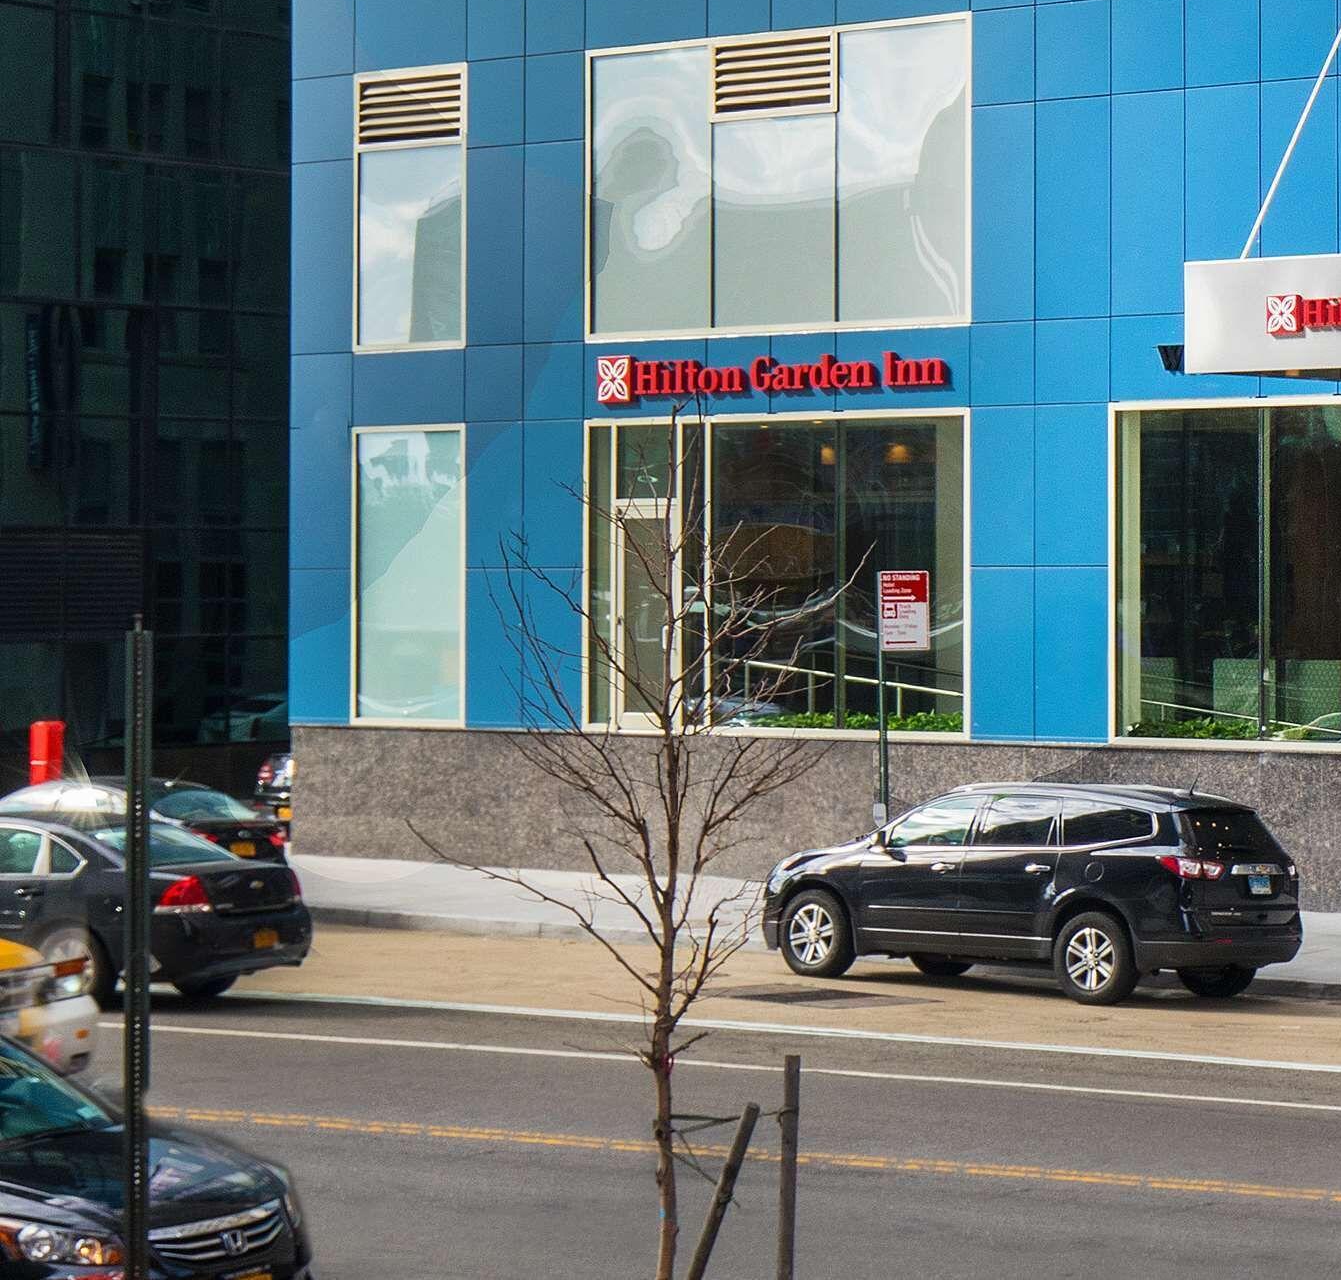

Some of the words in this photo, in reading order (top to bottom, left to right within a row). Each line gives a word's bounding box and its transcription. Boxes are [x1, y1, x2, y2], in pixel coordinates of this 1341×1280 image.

[634, 359, 743, 394] Hilton
[751, 353, 873, 390] Garden
[882, 350, 944, 386] Inn
